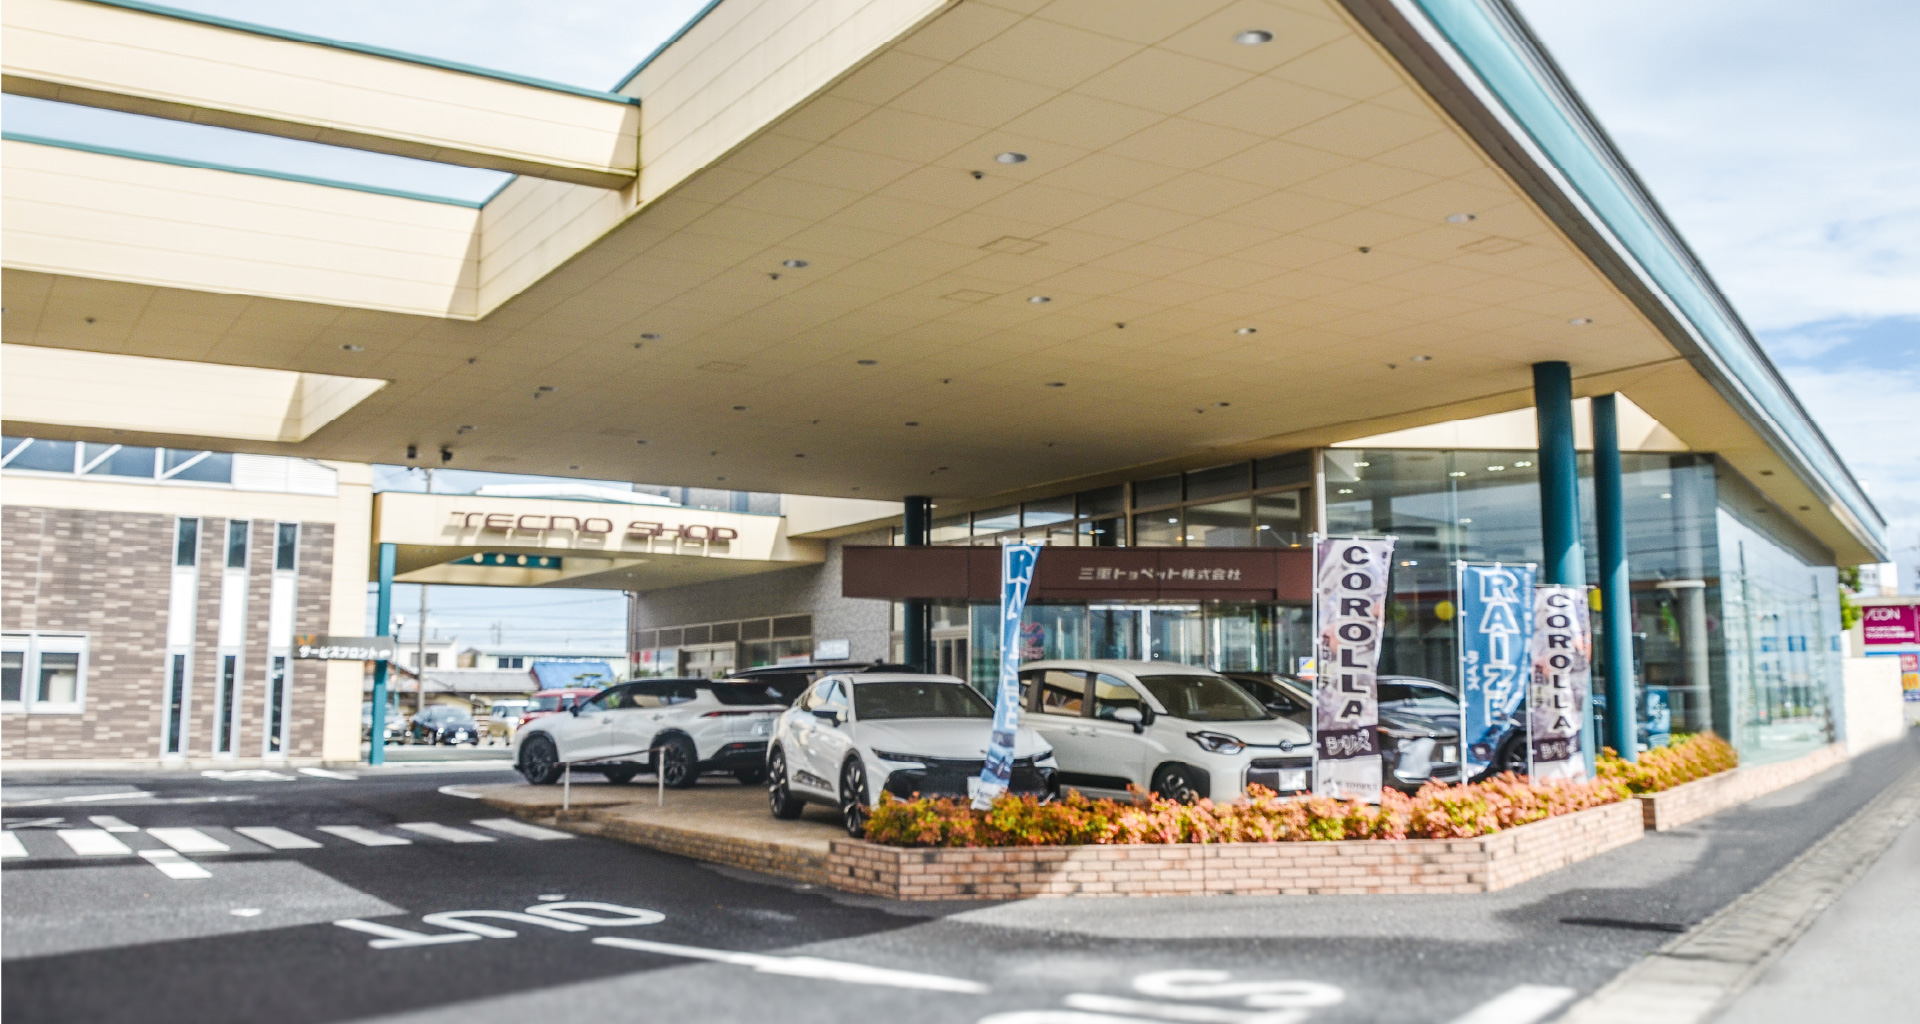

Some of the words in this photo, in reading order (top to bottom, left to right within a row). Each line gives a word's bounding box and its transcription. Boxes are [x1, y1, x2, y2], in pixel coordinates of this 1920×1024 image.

[451, 511, 613, 534] TECNO
[628, 520, 738, 541] SHOP
[1338, 545, 1373, 719] COROLLA
[1547, 593, 1572, 730] COROLLA
[333, 901, 666, 949] OUT
